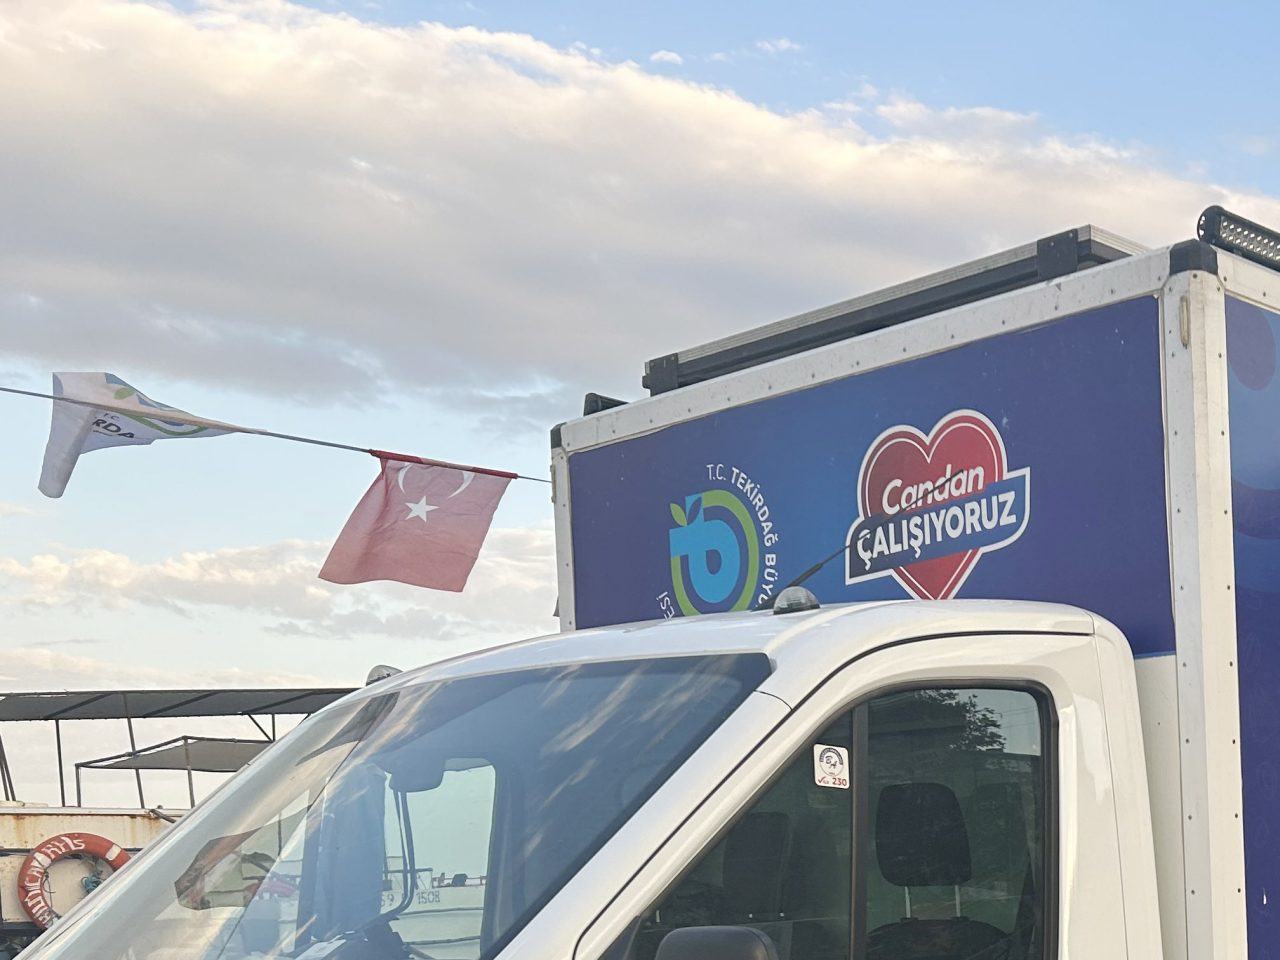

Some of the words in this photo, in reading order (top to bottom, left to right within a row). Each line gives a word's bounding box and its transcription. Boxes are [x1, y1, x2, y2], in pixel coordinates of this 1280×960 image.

[706, 463, 727, 481] T.C.
[731, 466, 779, 547] TEKİRDAĞ
[881, 463, 985, 516] Candan
[856, 490, 1017, 571] ÇALIŞIYORUZ
[832, 776, 848, 787] 230
